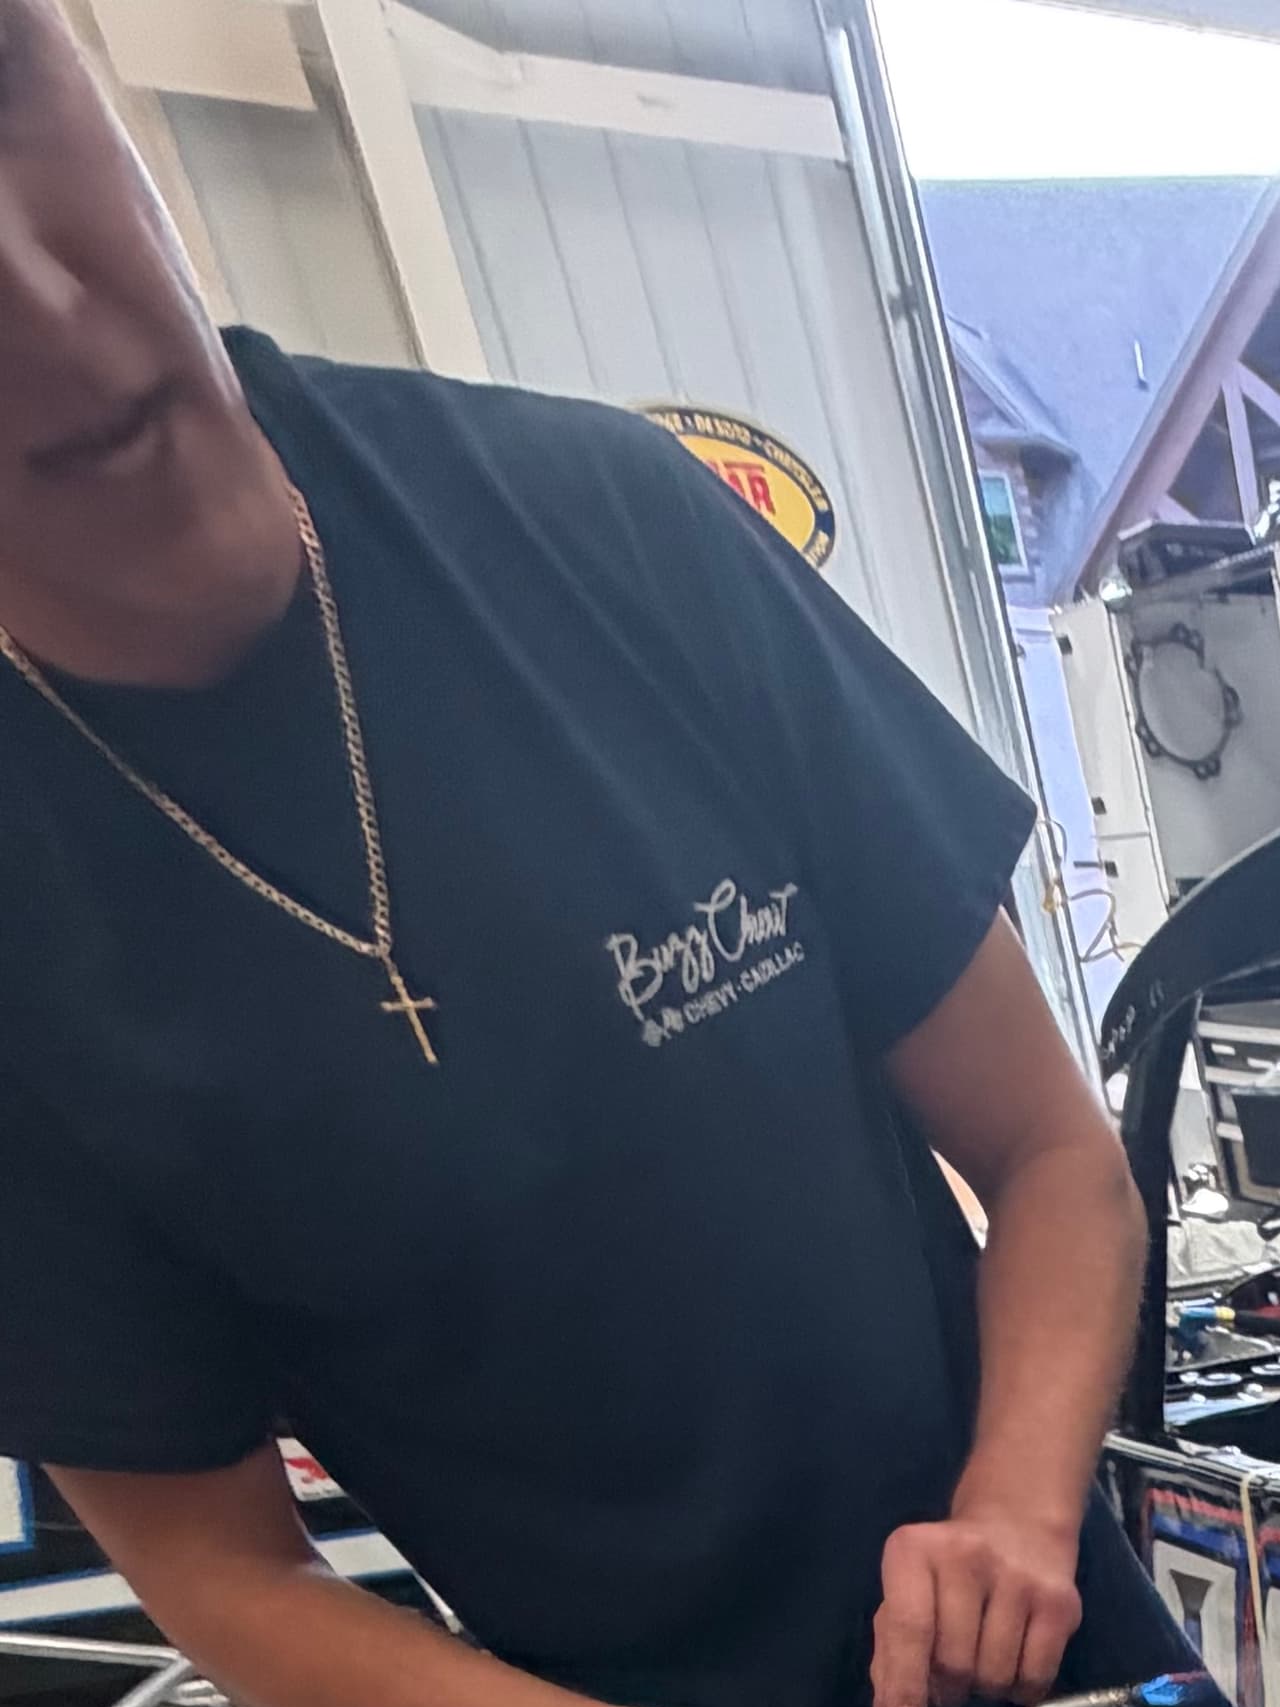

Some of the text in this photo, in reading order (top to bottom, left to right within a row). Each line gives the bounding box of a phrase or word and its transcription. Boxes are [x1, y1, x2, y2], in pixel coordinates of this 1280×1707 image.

[605, 924, 716, 1022] Buzz
[683, 940, 805, 1026] CHEVY CADILLAC
